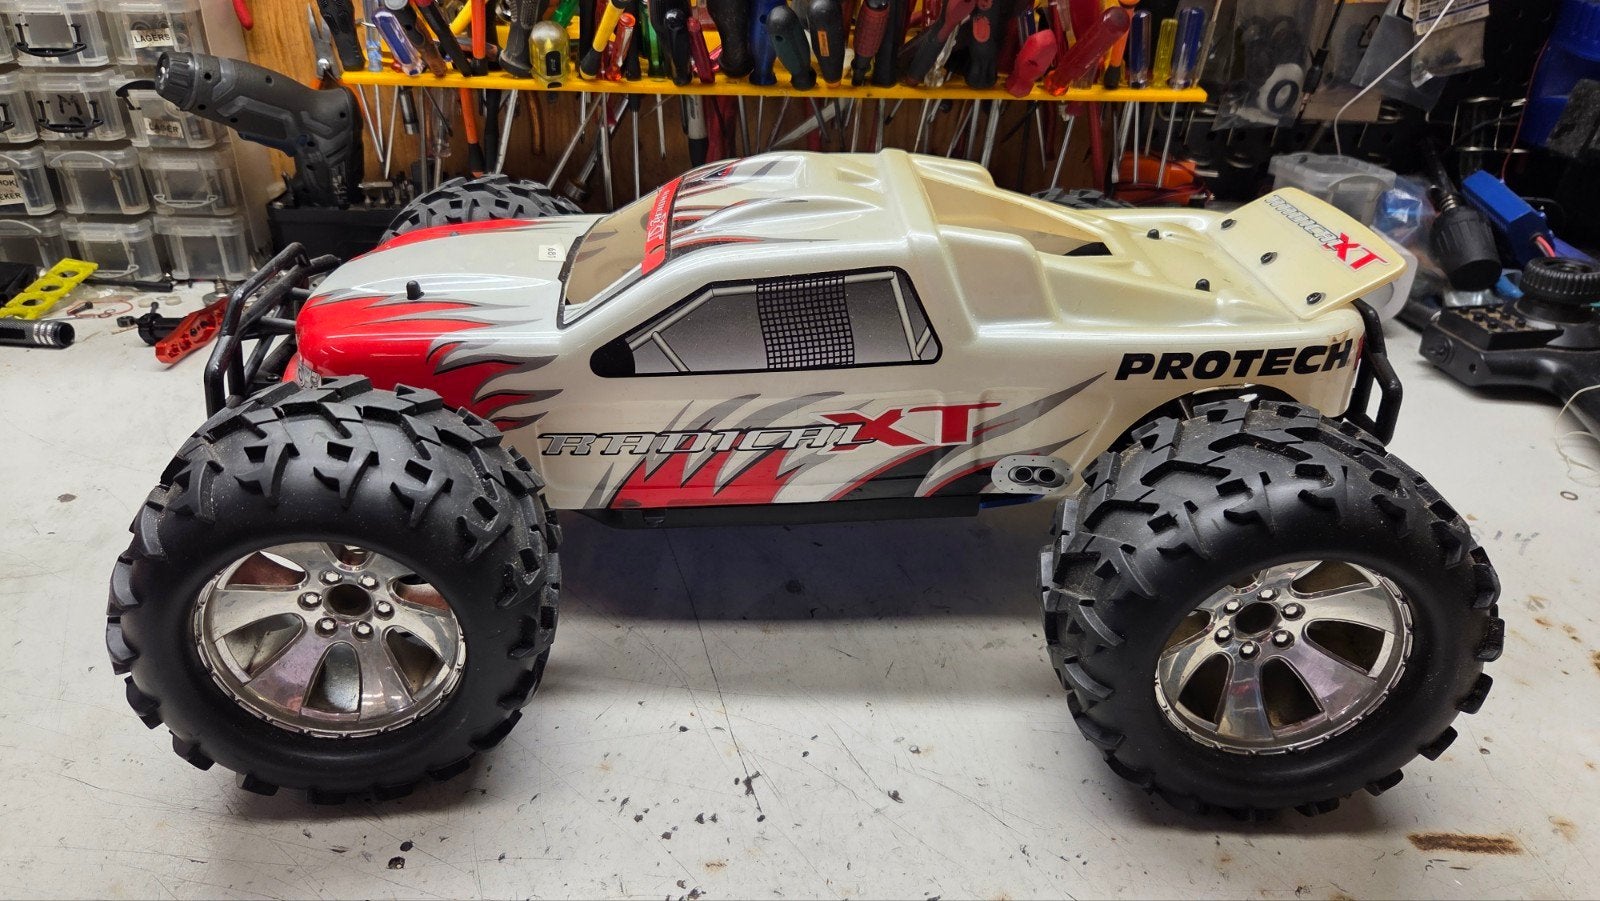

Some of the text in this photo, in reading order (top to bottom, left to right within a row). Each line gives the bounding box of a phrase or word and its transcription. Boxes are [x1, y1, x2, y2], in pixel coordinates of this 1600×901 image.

[134, 33, 171, 43] LAGERS
[149, 122, 179, 133] LAGER
[1114, 338, 1354, 381] PROTECH
[537, 402, 1003, 456] RADICAL XT
